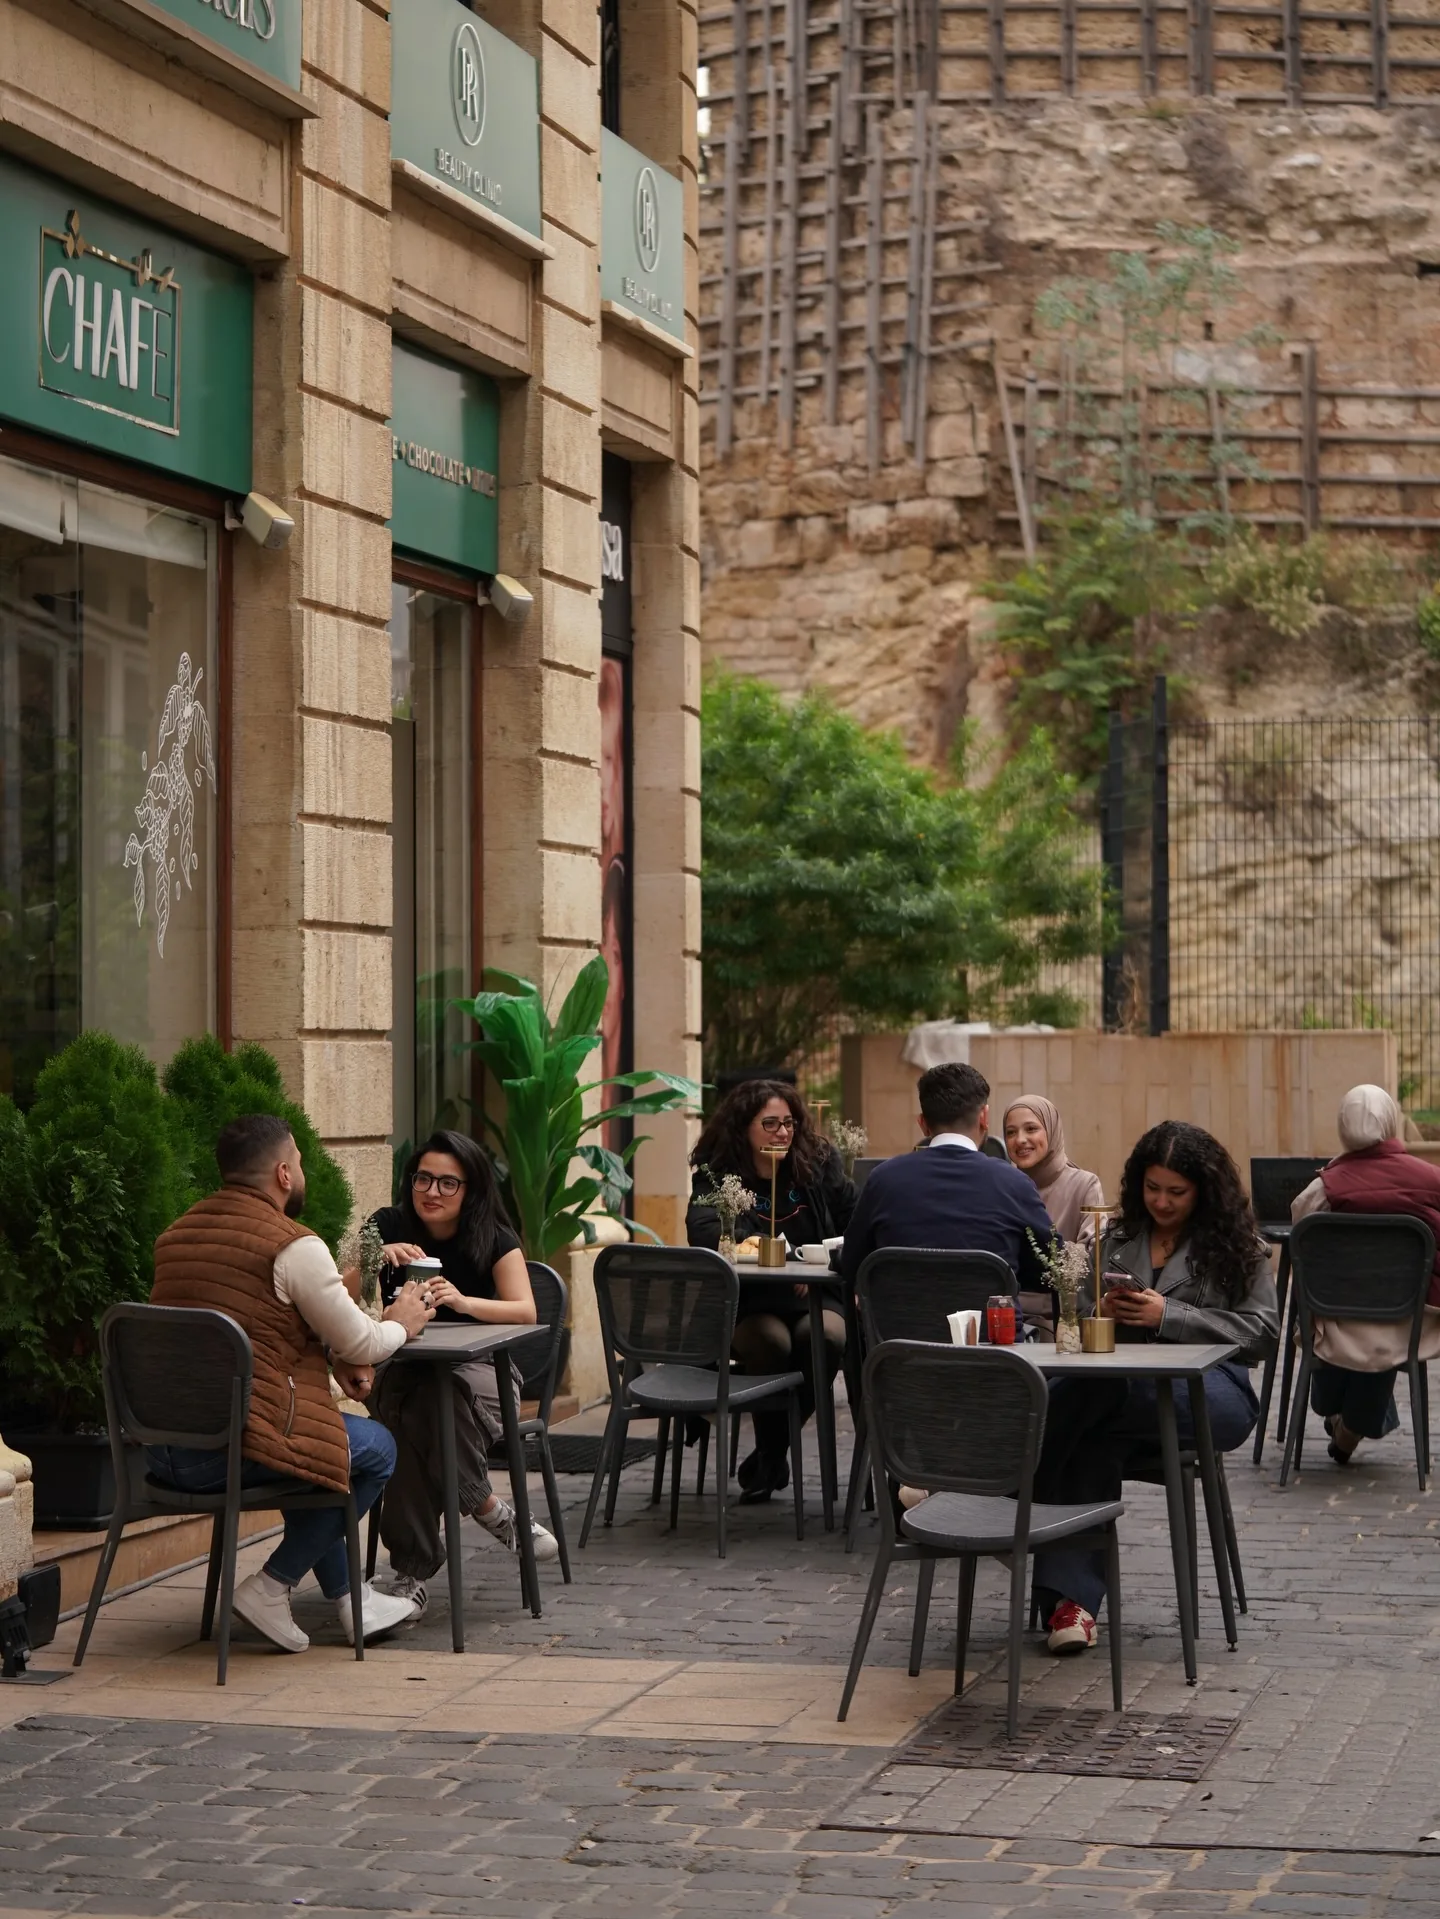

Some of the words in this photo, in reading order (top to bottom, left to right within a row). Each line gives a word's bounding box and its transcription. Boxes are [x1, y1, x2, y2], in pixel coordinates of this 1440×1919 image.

[438, 148, 473, 188] BEAUTY
[43, 267, 172, 402] CHAFE
[407, 442, 464, 485] CHOCOLATE
